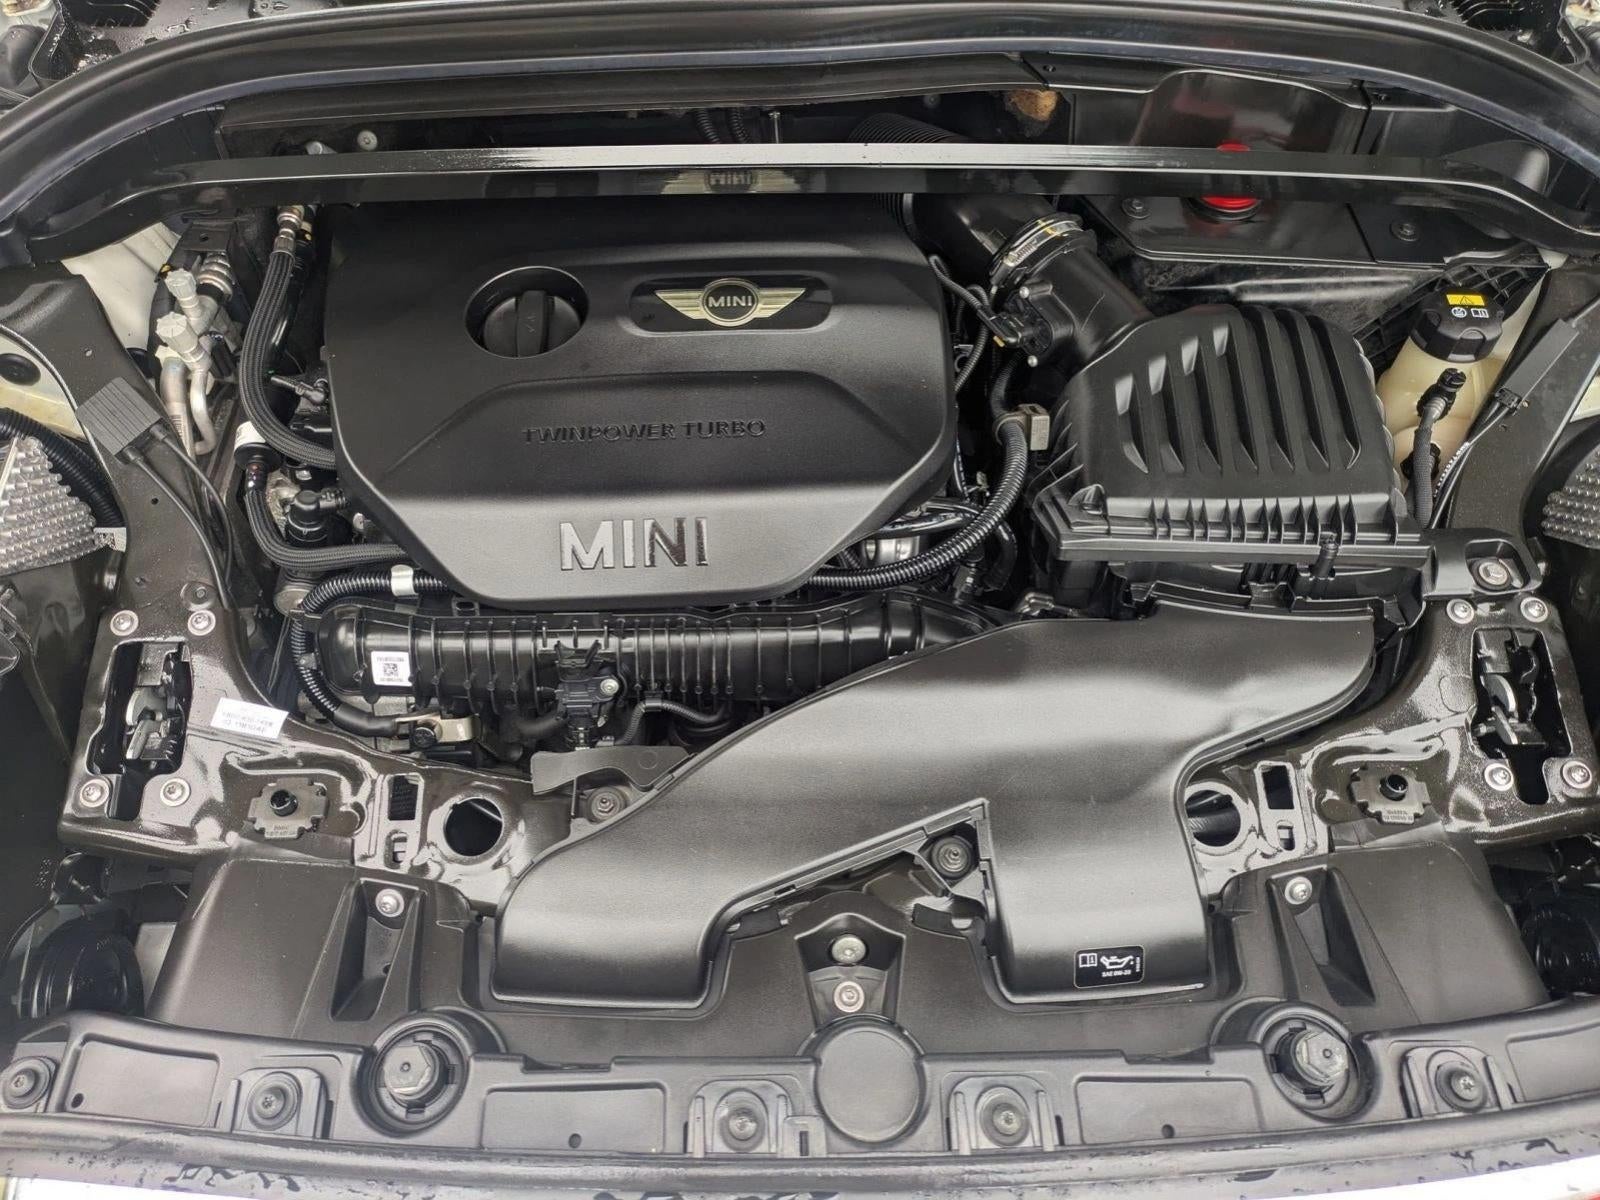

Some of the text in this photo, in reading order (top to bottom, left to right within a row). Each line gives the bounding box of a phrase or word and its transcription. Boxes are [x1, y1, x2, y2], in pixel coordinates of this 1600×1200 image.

[708, 295, 753, 308] MINI
[522, 418, 767, 445] TWINPOWER TURBO
[559, 516, 709, 572] MINI
